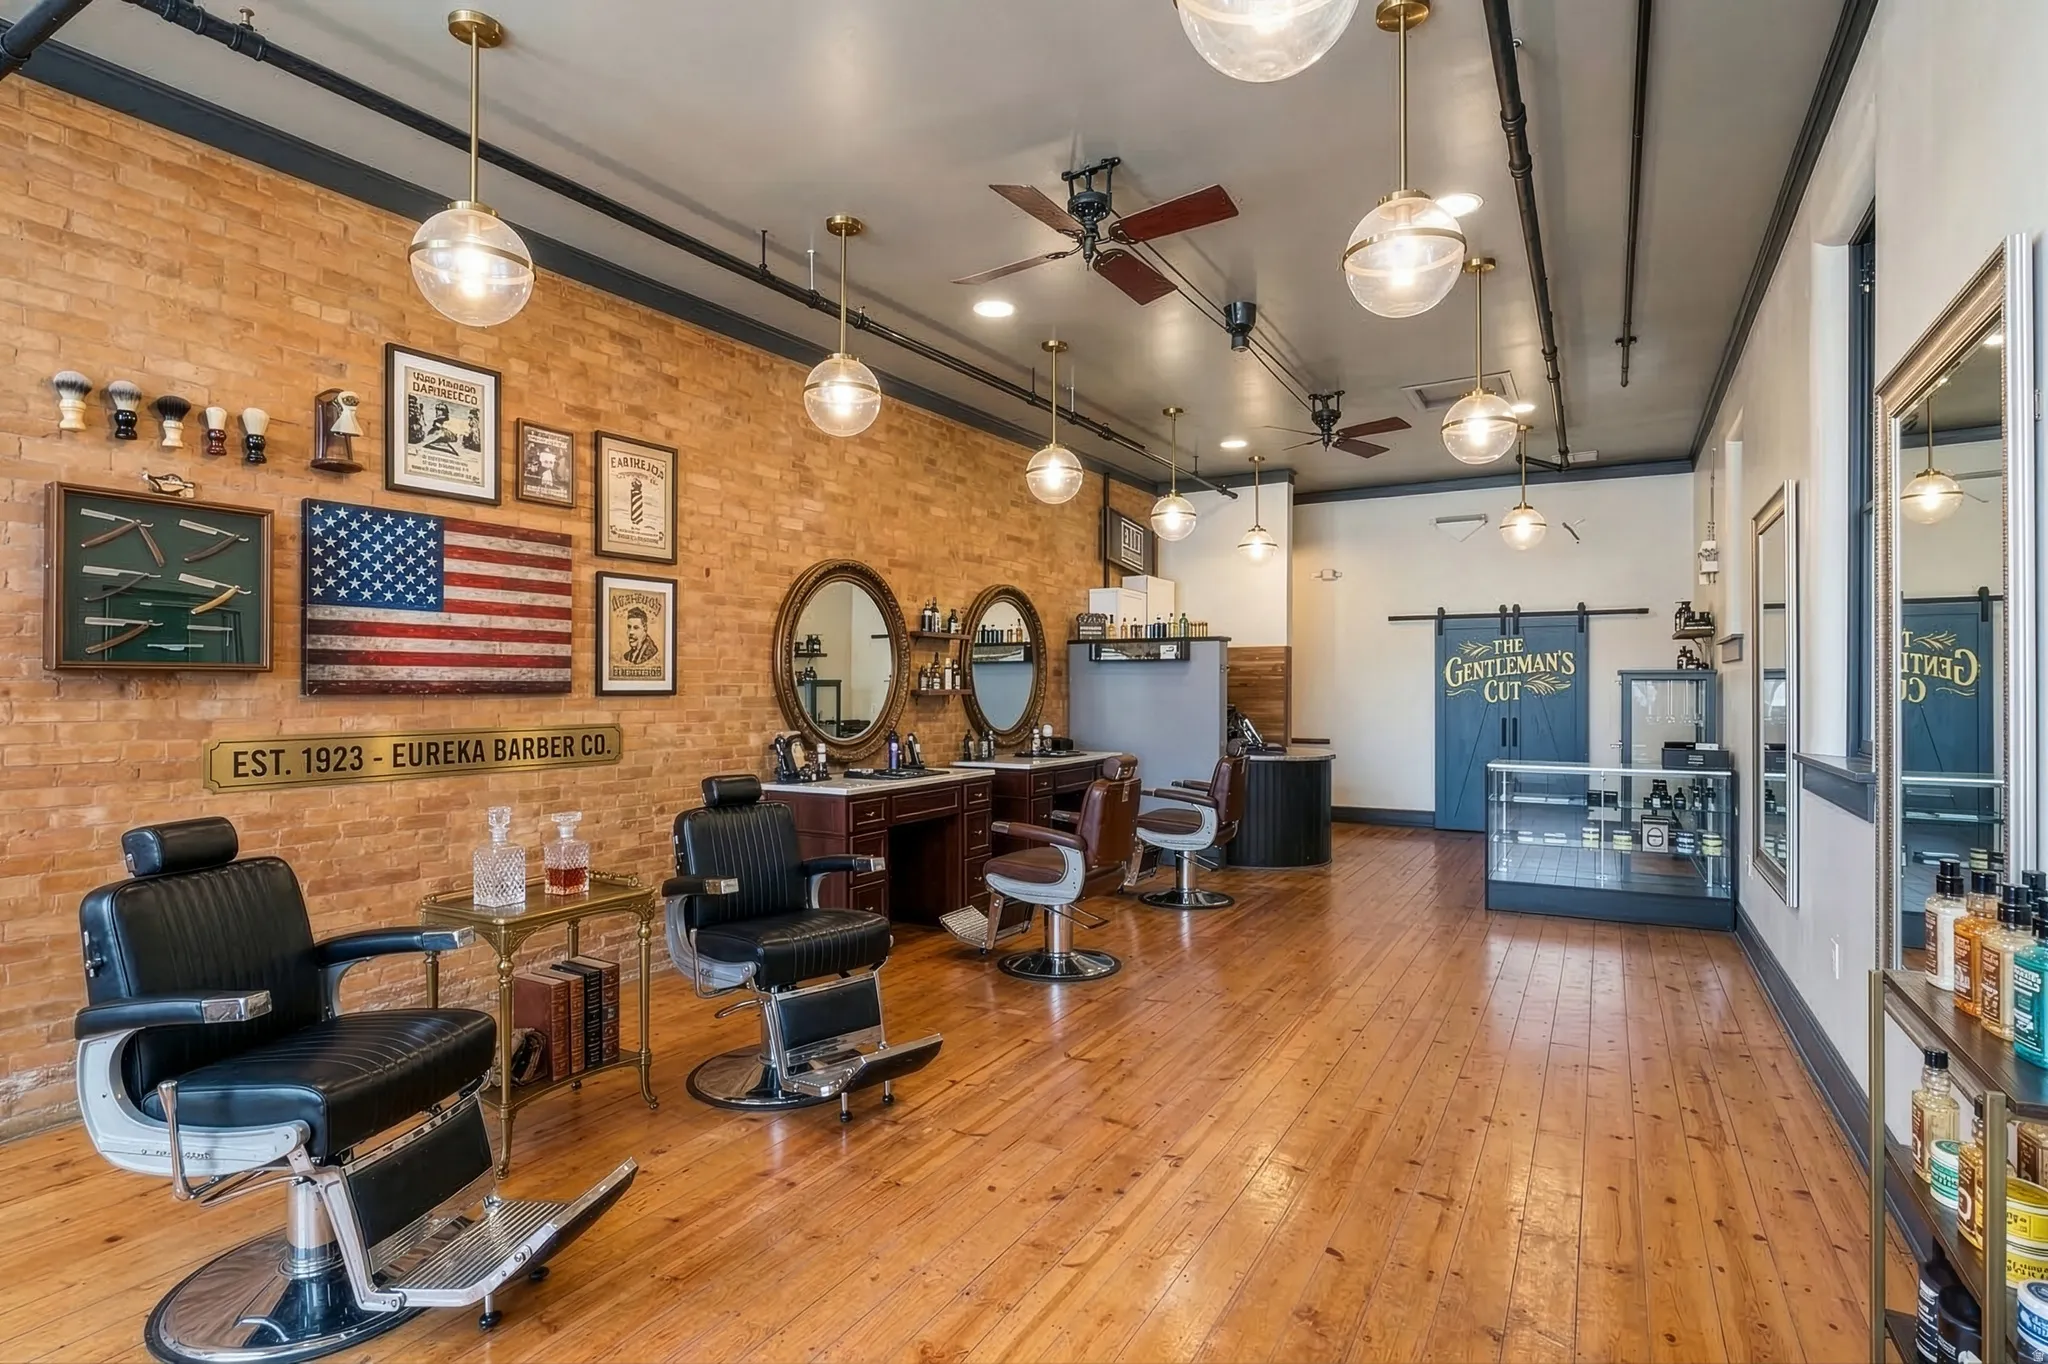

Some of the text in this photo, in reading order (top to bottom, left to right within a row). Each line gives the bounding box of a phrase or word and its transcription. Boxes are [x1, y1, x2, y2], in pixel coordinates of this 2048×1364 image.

[1492, 638, 1524, 655] THE
[1444, 650, 1576, 687] GENTLEMAN'S
[1483, 679, 1522, 703] CUT
[233, 749, 291, 778] EST.
[302, 745, 363, 774] 1923
[393, 739, 485, 768] EUREKA
[494, 735, 574, 762] BARBER
[581, 734, 611, 756] CO.
